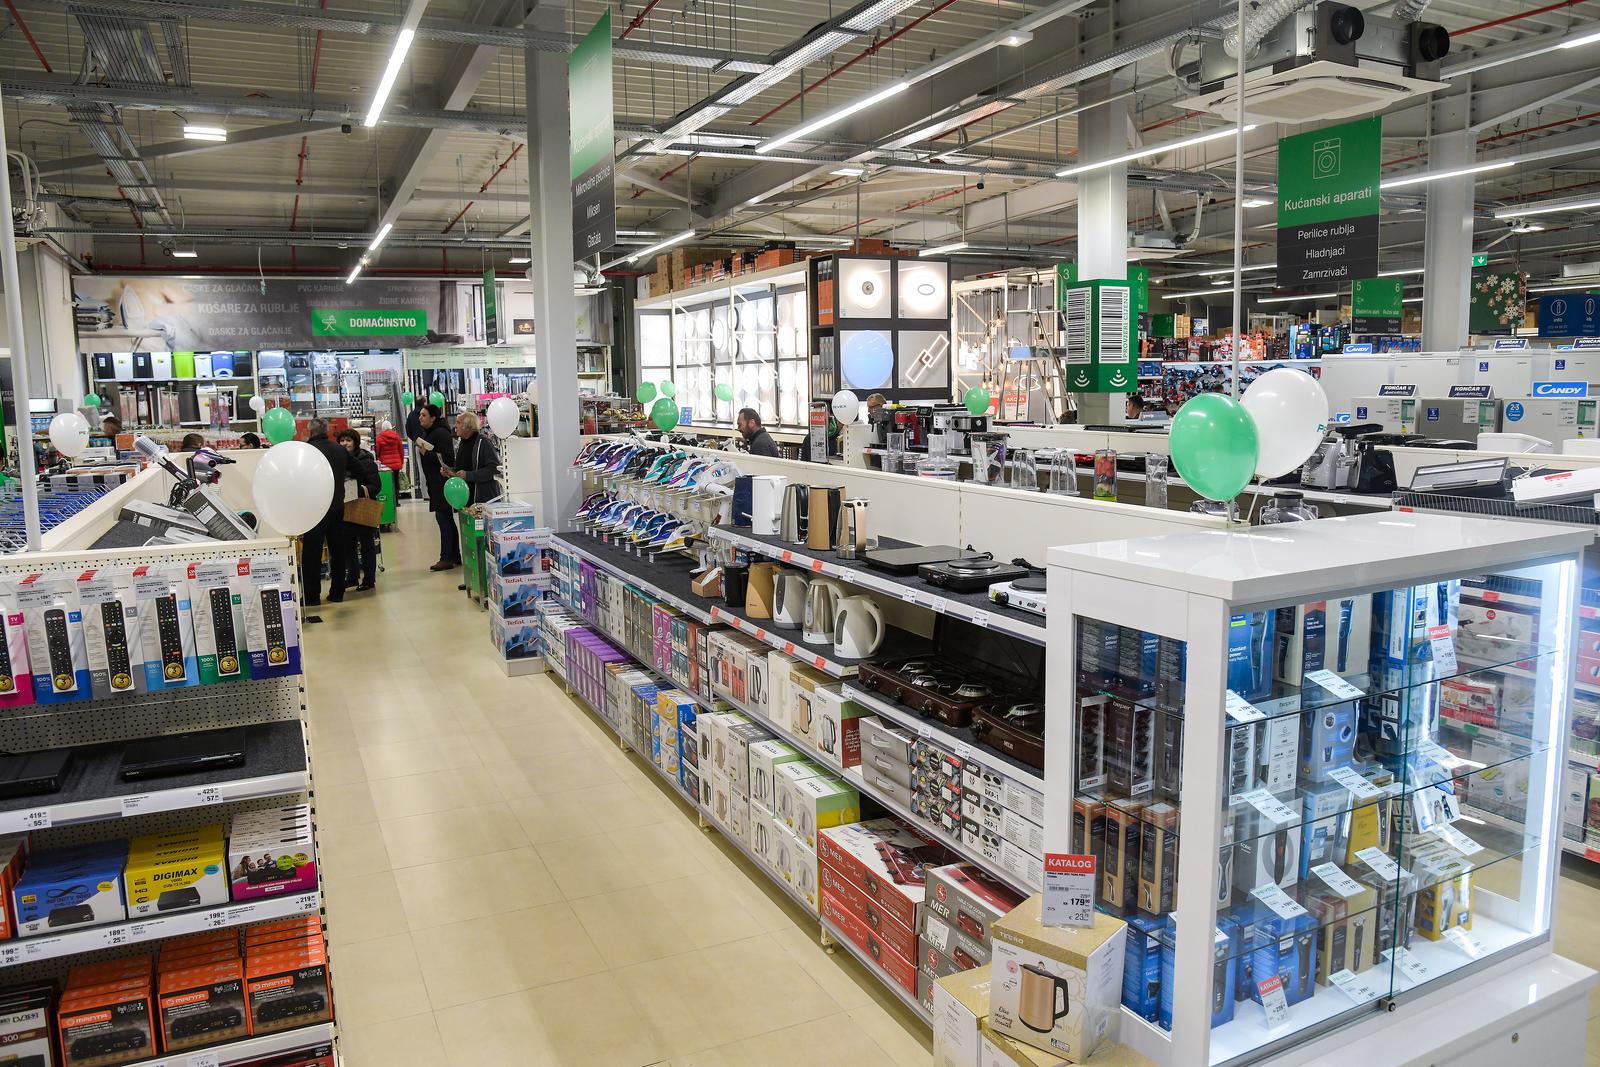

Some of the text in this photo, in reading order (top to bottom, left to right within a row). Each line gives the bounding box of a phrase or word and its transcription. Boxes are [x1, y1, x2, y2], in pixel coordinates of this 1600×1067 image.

[1284, 185, 1373, 211] Kućanski aparati
[1297, 223, 1355, 240] Perilice rublja
[1305, 245, 1346, 260] Hladnjaci
[1063, 268, 1070, 280] 3
[1137, 271, 1144, 282] 4
[1302, 265, 1348, 280] Zamrzivači
[1356, 281, 1400, 293] 5 6
[198, 301, 300, 313] KOŠARE ZA RUBLJE
[349, 316, 417, 328] DOMAĆINSTVO
[208, 326, 293, 336] DASKE ZA GLAČANJE
[1112, 700, 1132, 711] beper
[984, 788, 999, 801] DKP-1
[983, 818, 998, 831] DKP-1
[829, 847, 843, 863] MER
[983, 848, 997, 862] DKP-1
[1048, 859, 1092, 868] KATALOG
[153, 867, 198, 882] DIGIMAX
[832, 878, 845, 895] MER
[299, 896, 311, 904] 219
[1070, 898, 1085, 906] 179
[930, 899, 950, 919] MER
[832, 908, 846, 924] MER
[1074, 913, 1084, 921] 23
[108, 929, 121, 937] 189
[923, 998, 935, 1015] ME
[2, 1033, 19, 1043] 300
